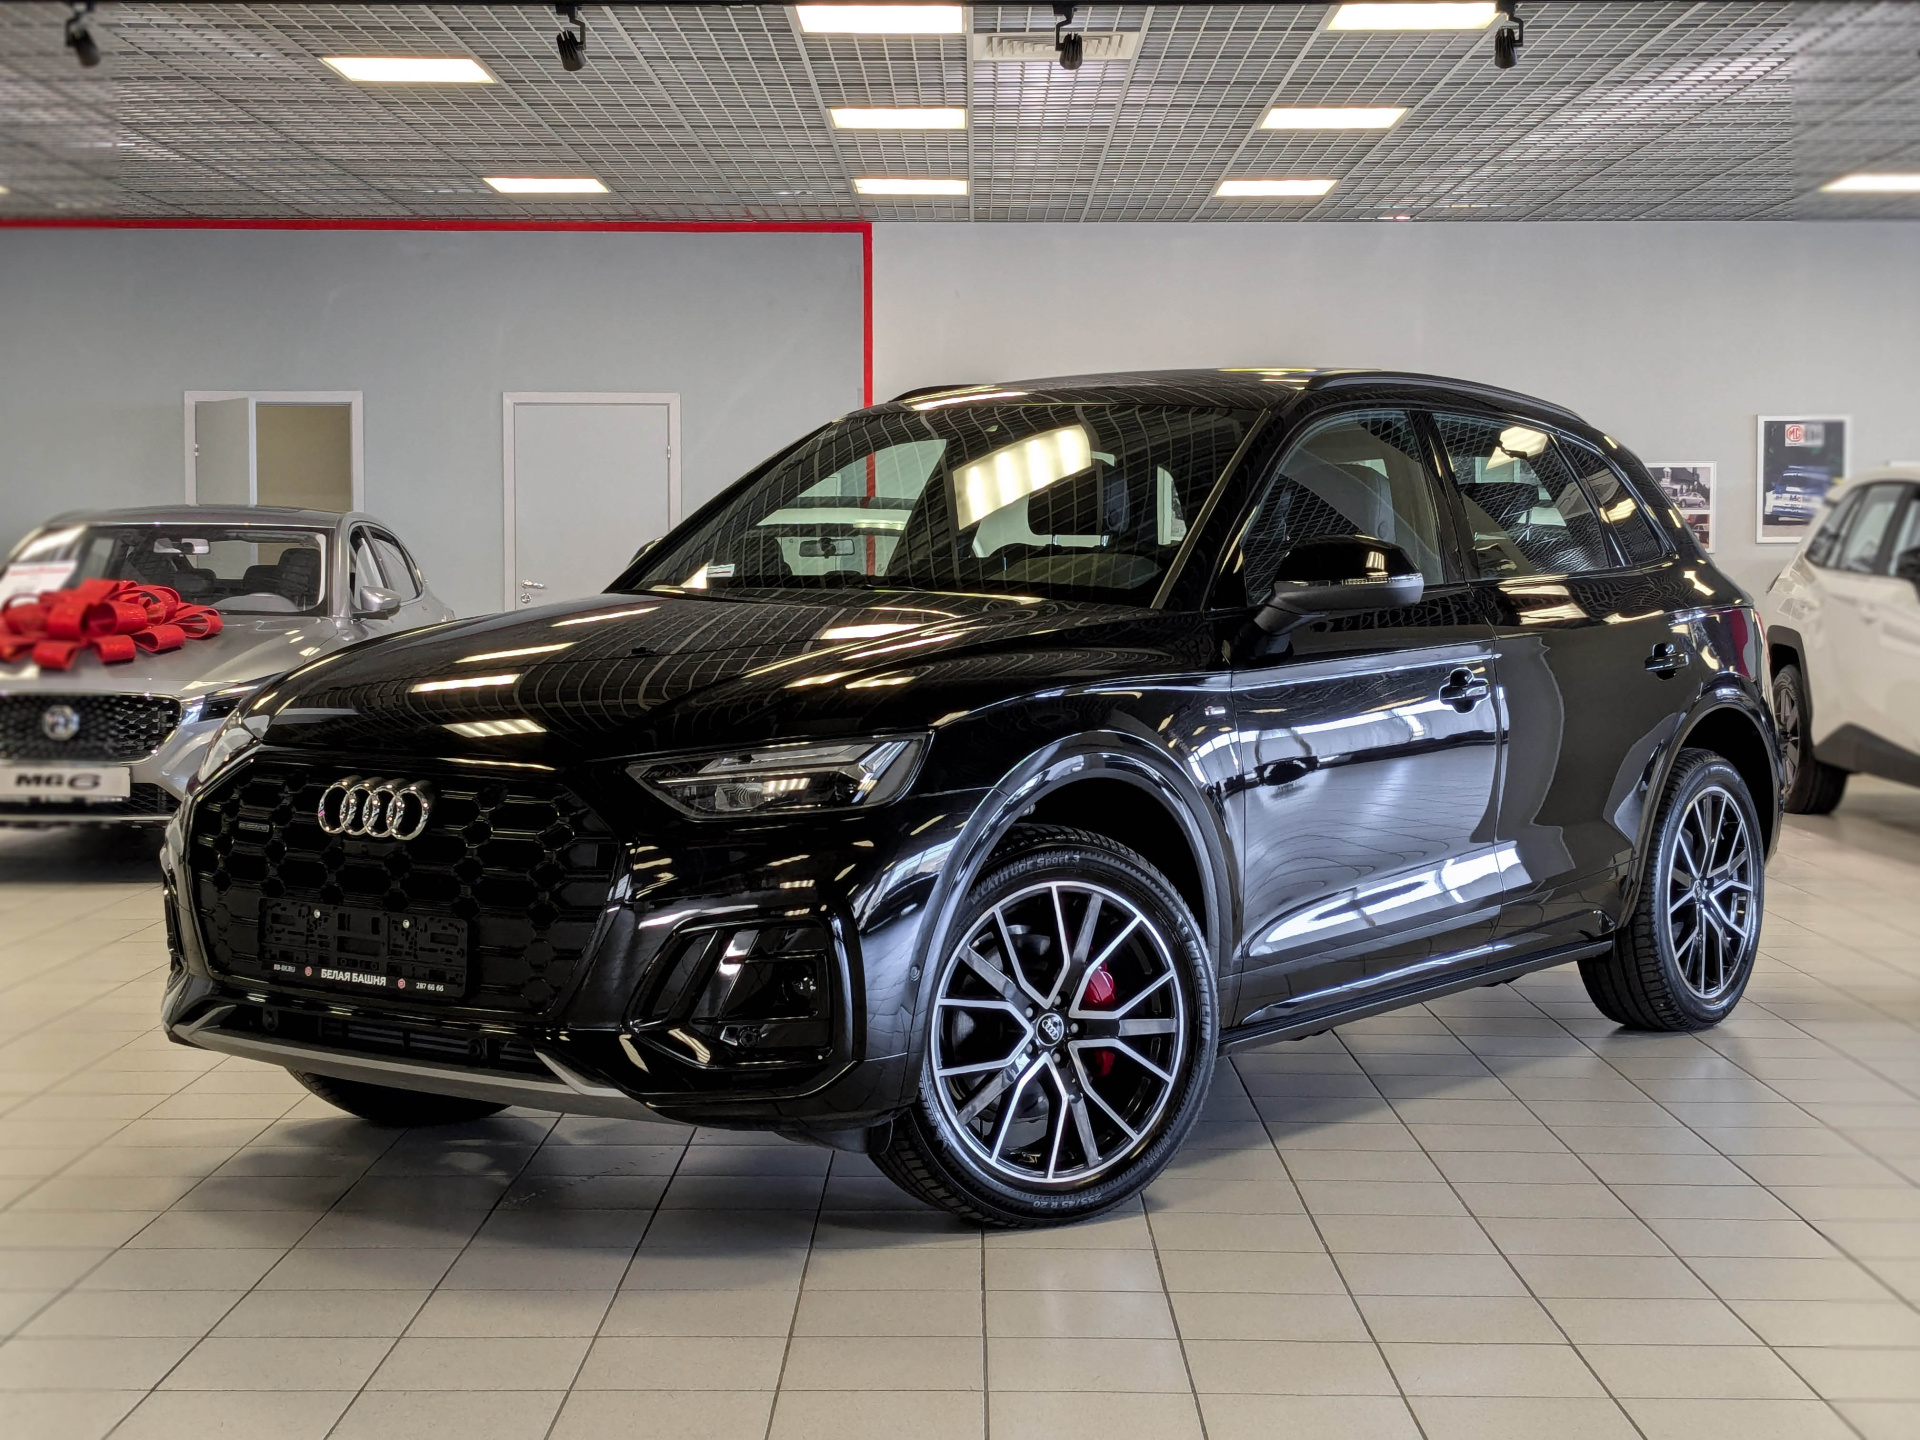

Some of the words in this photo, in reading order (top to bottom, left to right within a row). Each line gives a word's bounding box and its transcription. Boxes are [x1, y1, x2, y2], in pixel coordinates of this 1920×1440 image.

[980, 860, 1034, 896] LATITUDE
[1036, 854, 1069, 868] Sport
[1071, 854, 1080, 863] 3
[321, 968, 351, 982] БЕЛАЯ
[352, 972, 387, 986] БАШНЯ
[1186, 940, 1211, 1040] MICHELIN
[1033, 1200, 1048, 1208] 20
[1061, 1192, 1102, 1209] 255/45
